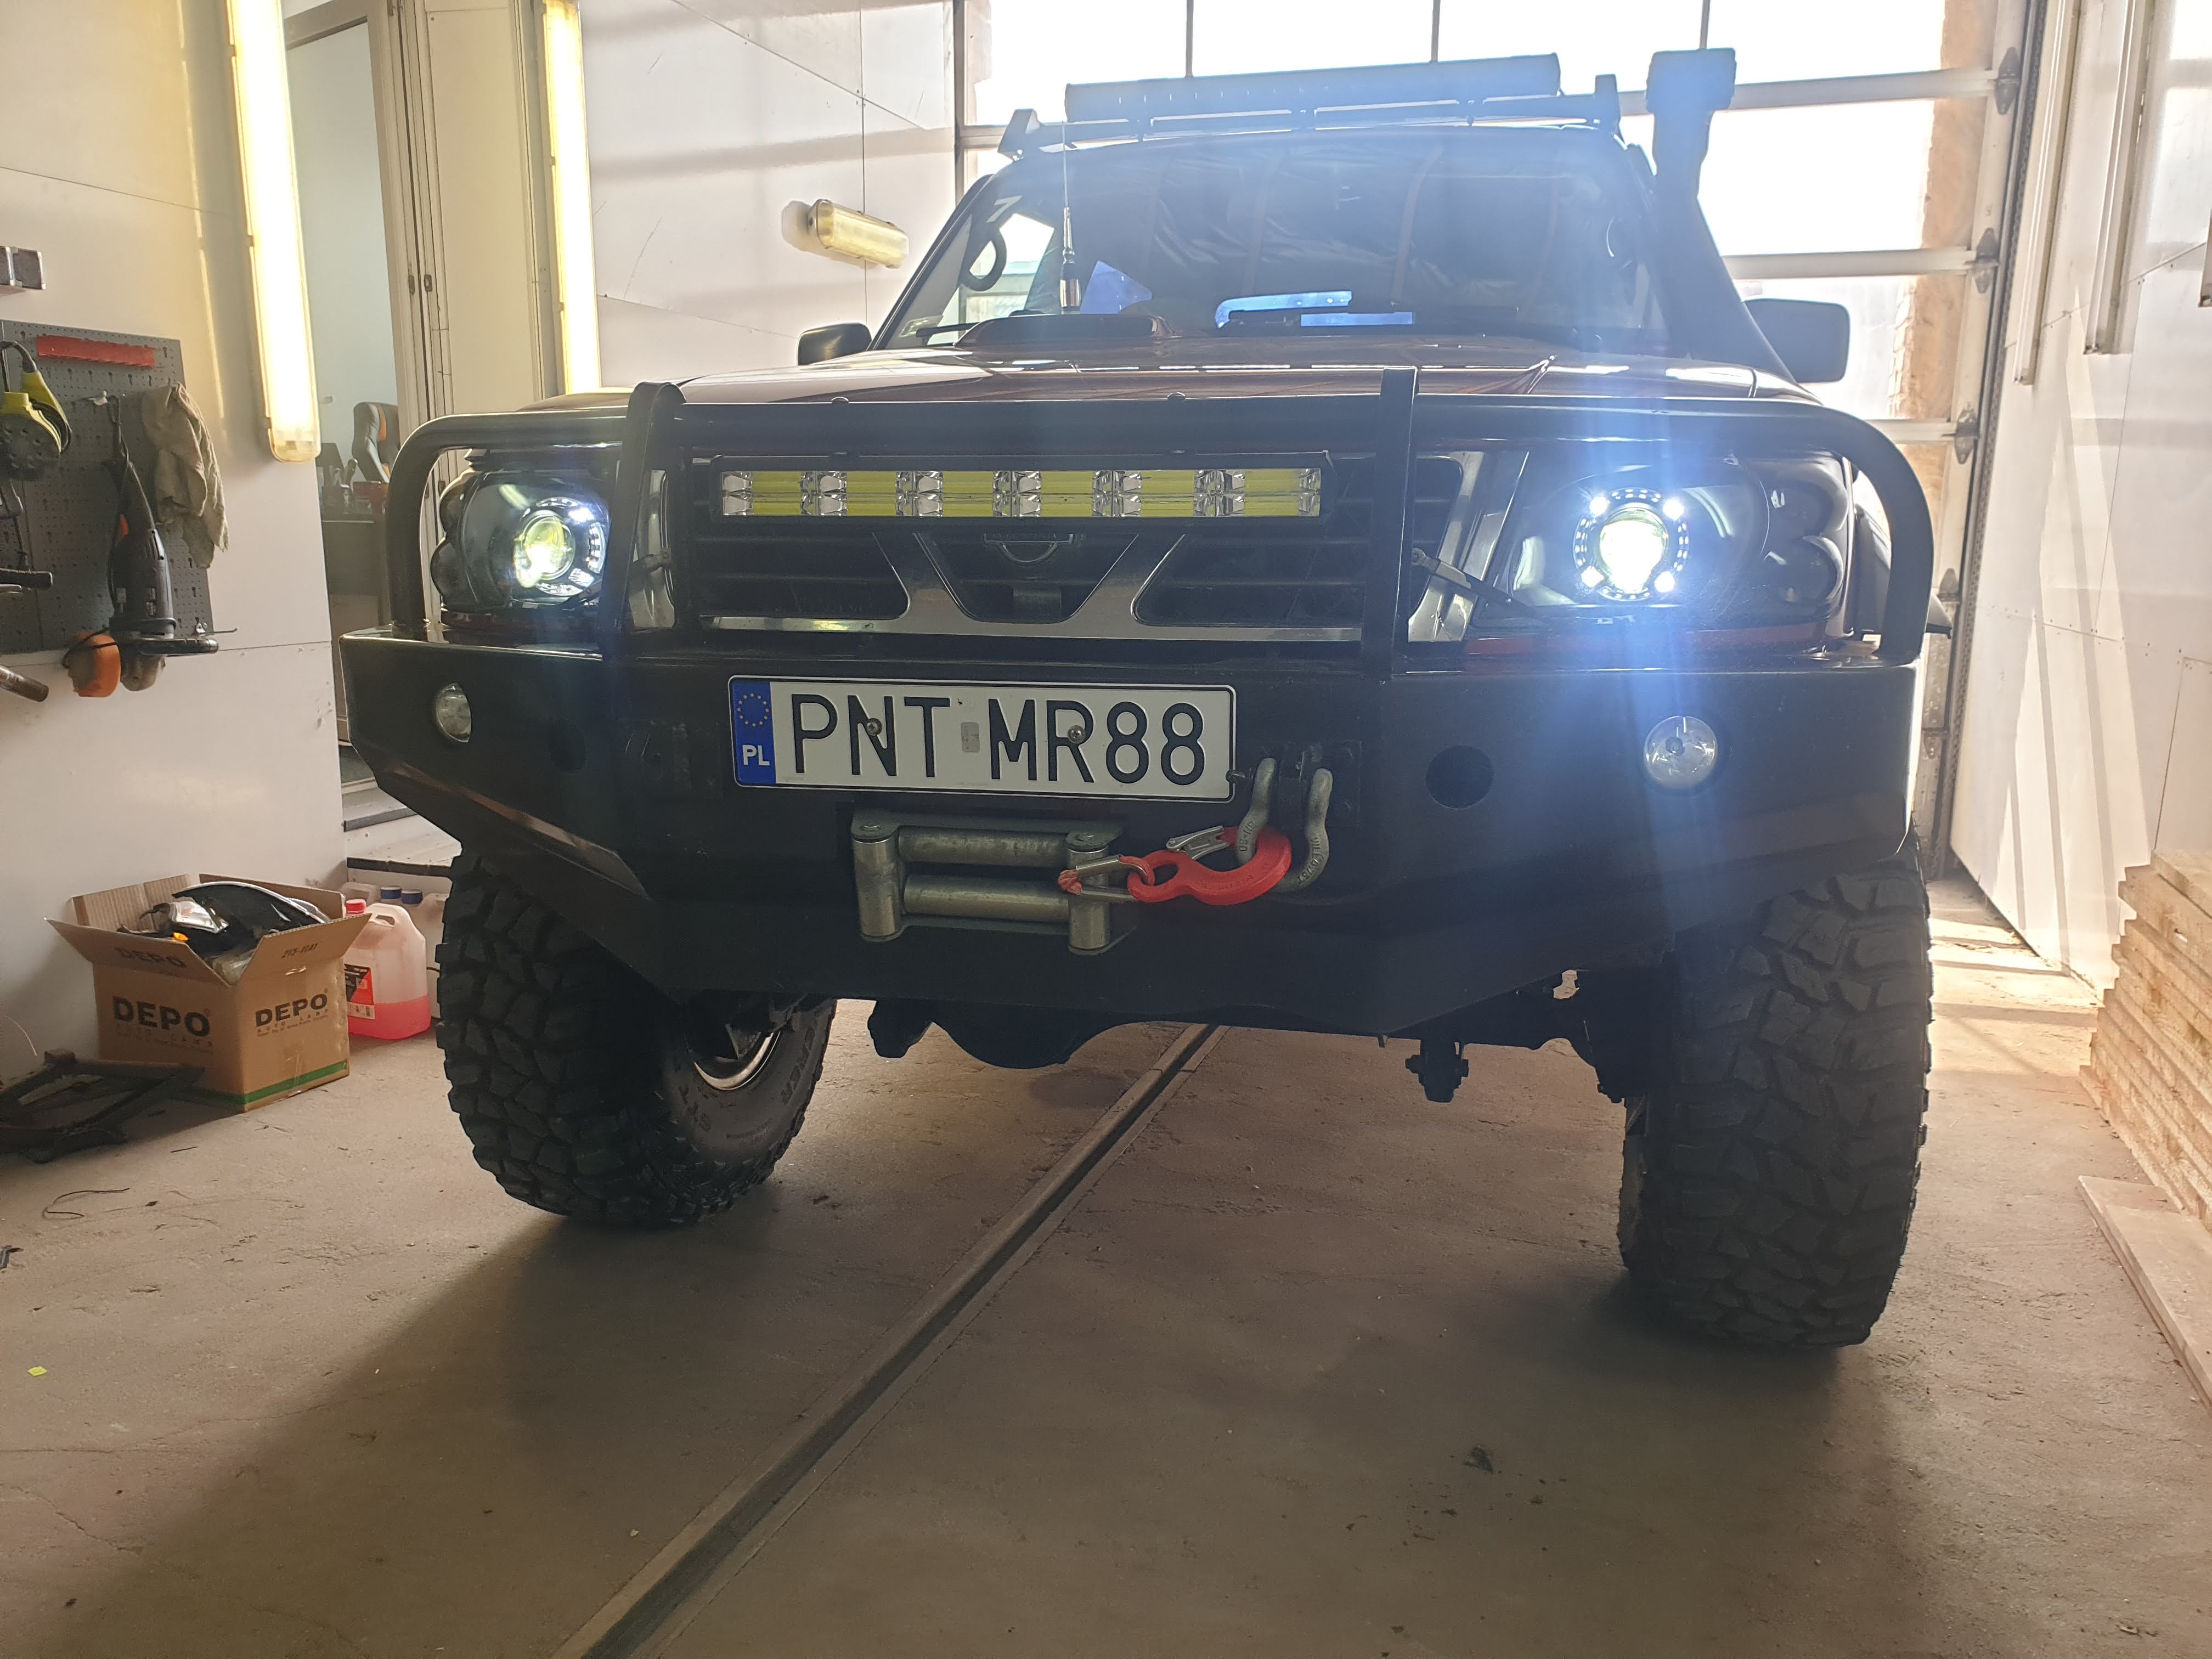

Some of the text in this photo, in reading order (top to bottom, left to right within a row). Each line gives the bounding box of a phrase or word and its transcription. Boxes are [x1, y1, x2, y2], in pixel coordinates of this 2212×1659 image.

[742, 745, 770, 766] PL
[792, 693, 1206, 786] PNT MR88
[112, 996, 211, 1036] DEPO
[256, 994, 328, 1027] DEPO
